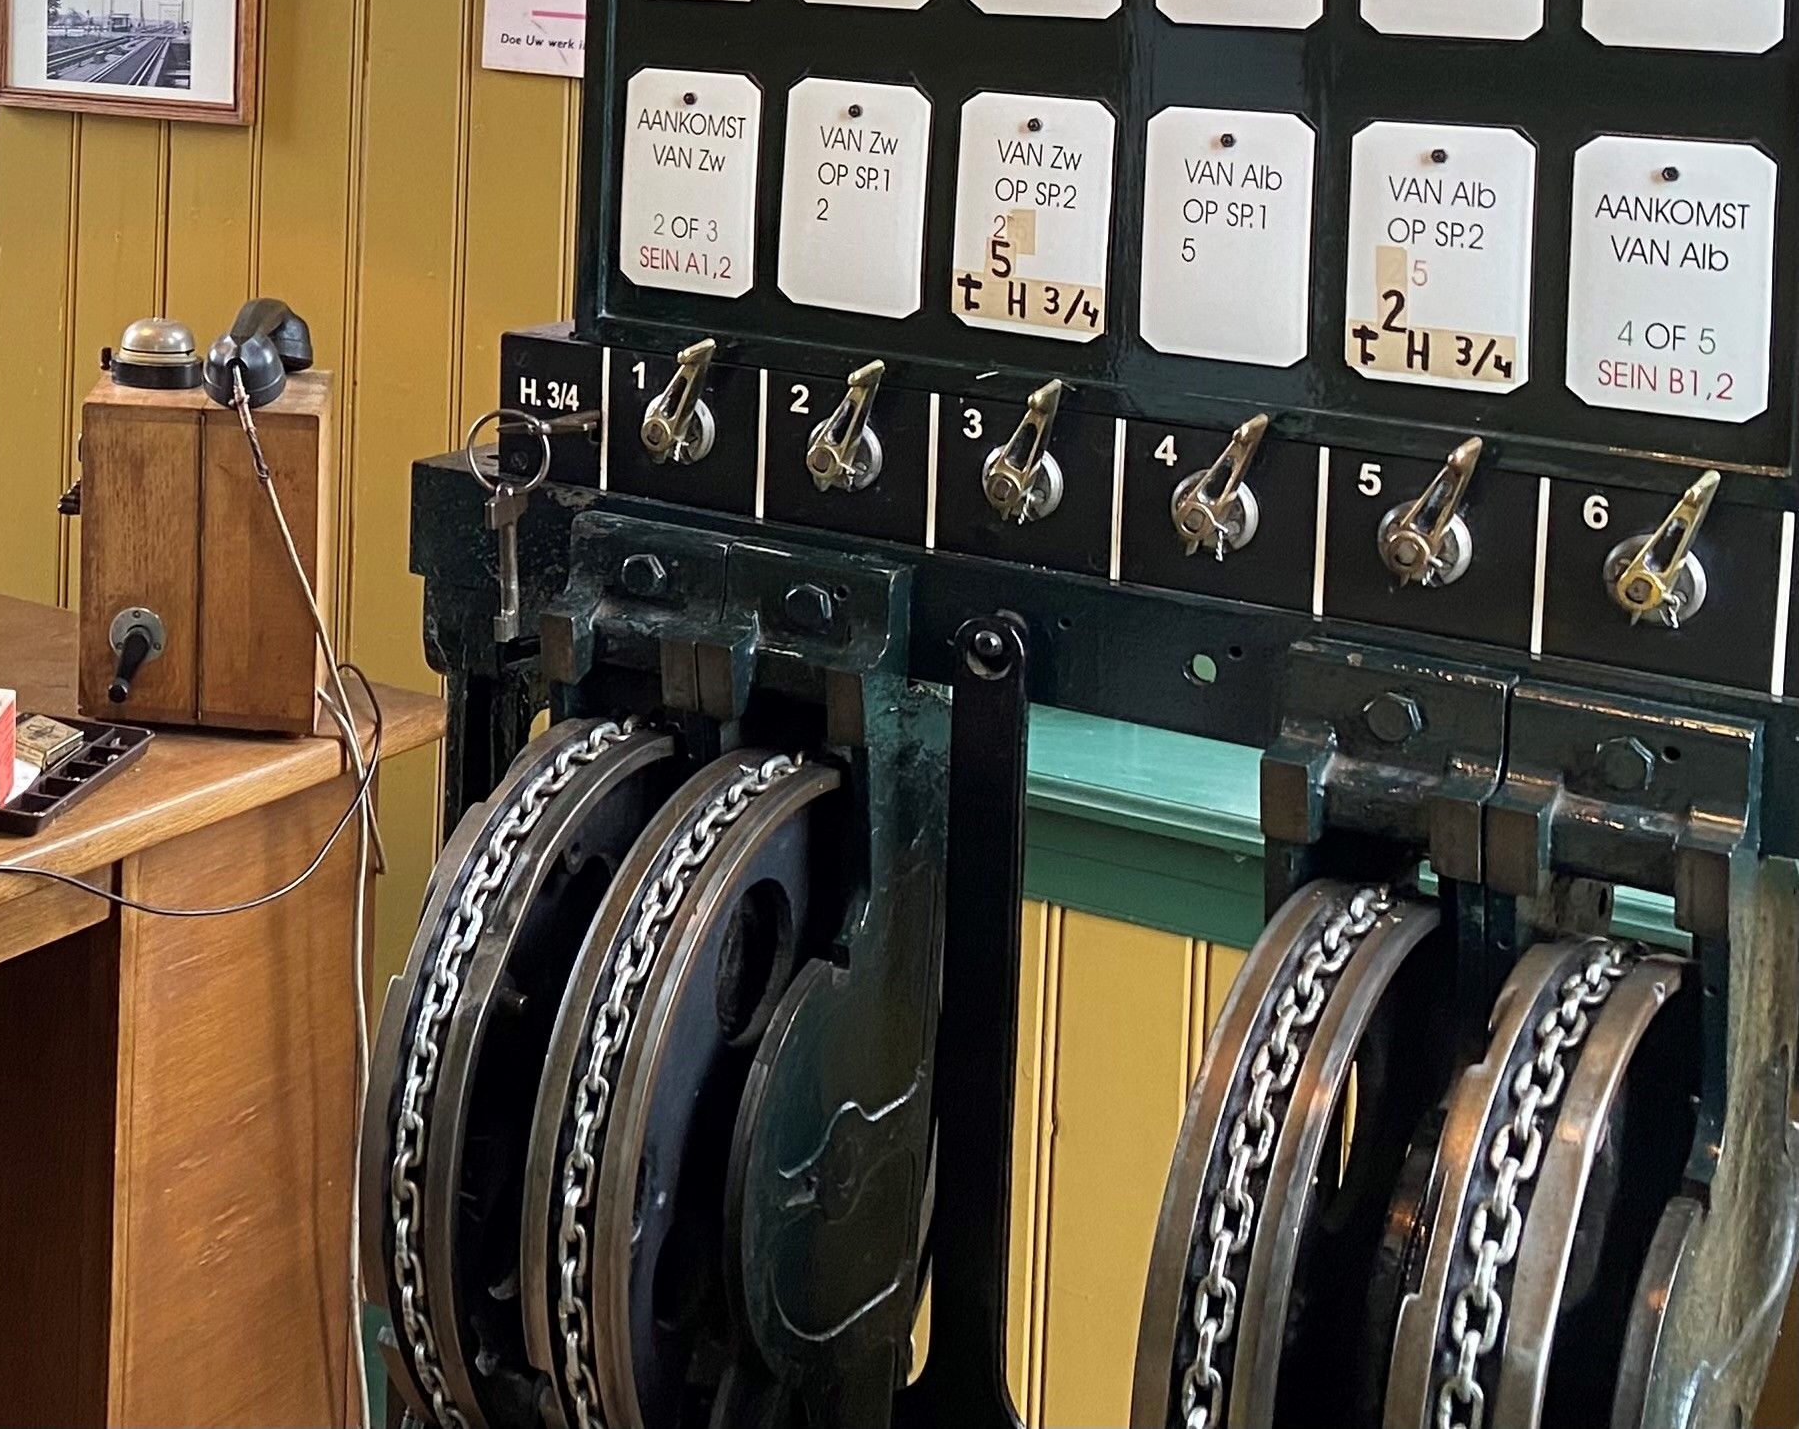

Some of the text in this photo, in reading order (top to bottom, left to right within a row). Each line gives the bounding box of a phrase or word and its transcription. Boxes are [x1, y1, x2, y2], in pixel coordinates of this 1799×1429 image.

[501, 33, 585, 50] Doe Uw werk i
[636, 108, 747, 140] AANKOMST
[819, 125, 899, 156] VAN Zw
[652, 143, 726, 172] VAN Zw
[997, 139, 1083, 171] VAN Zw
[817, 161, 890, 192] OP SP.1
[1184, 158, 1283, 191] VAN Alb
[994, 177, 1077, 210] OP SP.2
[1388, 175, 1497, 209] VAN Alb
[816, 197, 829, 222] 2
[1182, 198, 1267, 230] OP SP.1
[1594, 193, 1750, 230] AANKOMST
[653, 212, 719, 243] 2 OF 3
[992, 214, 1007, 240] 2
[1387, 217, 1484, 250] OP SP.2
[639, 245, 732, 280] SEIN A1,2
[991, 239, 1012, 279] 5
[1181, 237, 1196, 263] 5
[1610, 234, 1729, 272] VAN Alb
[1411, 259, 1429, 287] 5
[1007, 280, 1027, 320] H
[1043, 286, 1100, 328] 3/4
[1381, 289, 1408, 334] 2
[1406, 329, 1430, 372] H
[1455, 335, 1513, 379] 3/4
[1617, 320, 1717, 356] 4 OF 5
[632, 361, 646, 390] 1
[1597, 359, 1734, 401] SEIN B1,2
[520, 376, 580, 412] H. 3/4
[789, 383, 810, 415] 2
[962, 408, 983, 439] 3
[1154, 434, 1178, 467] 4
[1358, 462, 1382, 496] 5
[1583, 494, 1609, 530] 6
